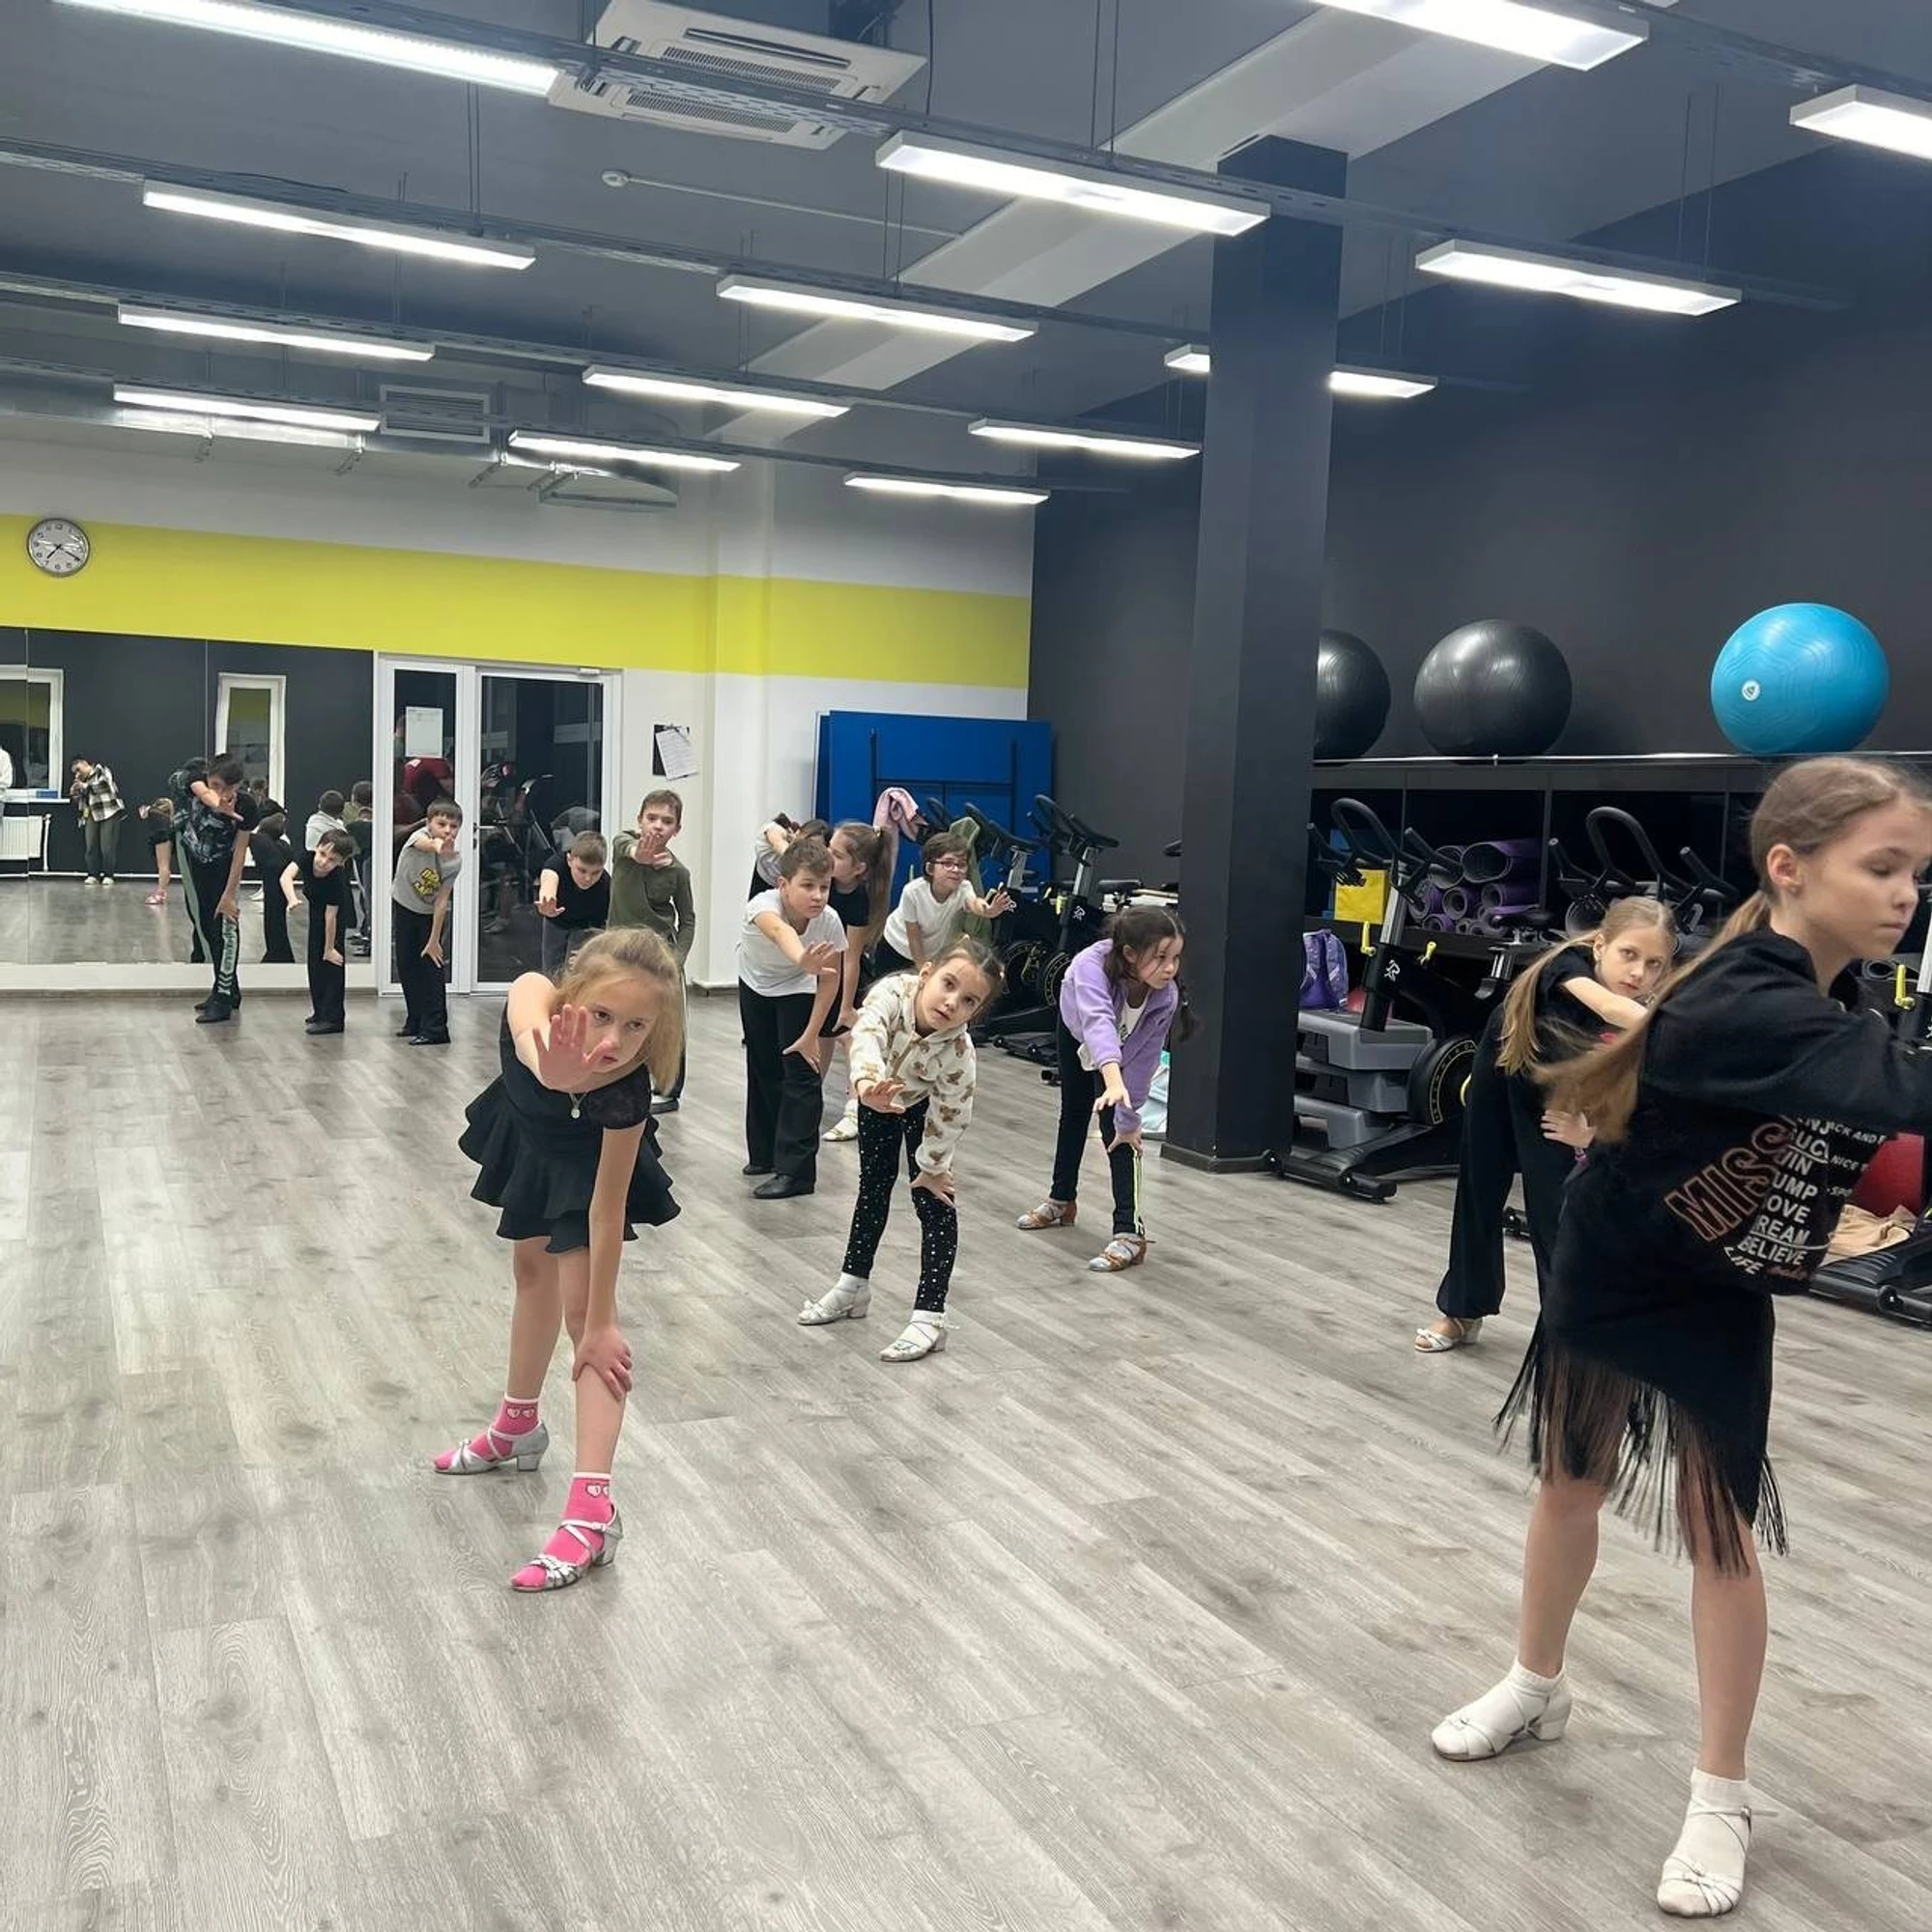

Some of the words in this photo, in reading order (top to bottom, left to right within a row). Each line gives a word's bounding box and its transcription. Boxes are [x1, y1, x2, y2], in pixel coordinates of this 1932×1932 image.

[1852, 1130, 1878, 1145] AND
[1764, 1195, 1811, 1224] OVE
[1737, 1235, 1808, 1265] BELIEVE
